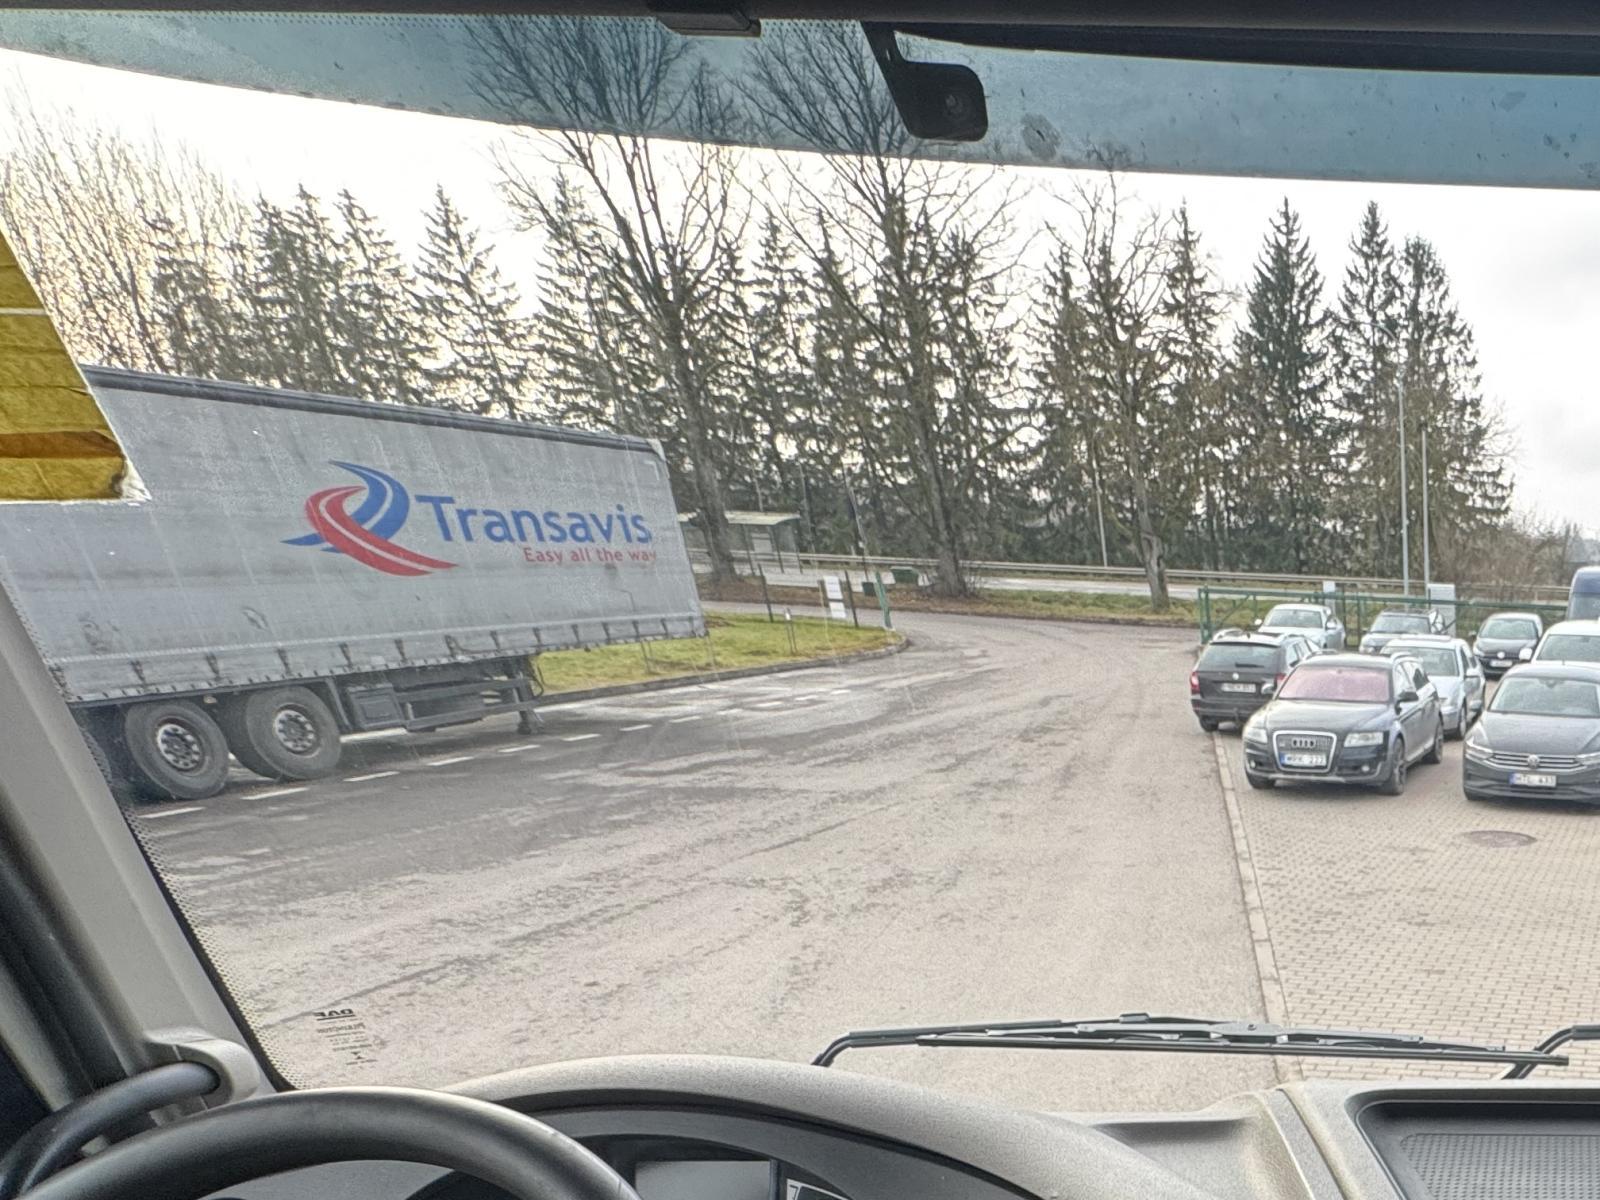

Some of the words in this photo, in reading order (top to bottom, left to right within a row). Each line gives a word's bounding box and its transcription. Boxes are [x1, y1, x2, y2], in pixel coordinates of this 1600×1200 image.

[414, 494, 654, 544] Transavis
[524, 548, 564, 564] Easy
[570, 548, 592, 563] all
[596, 549, 624, 562] the
[627, 551, 658, 565] way
